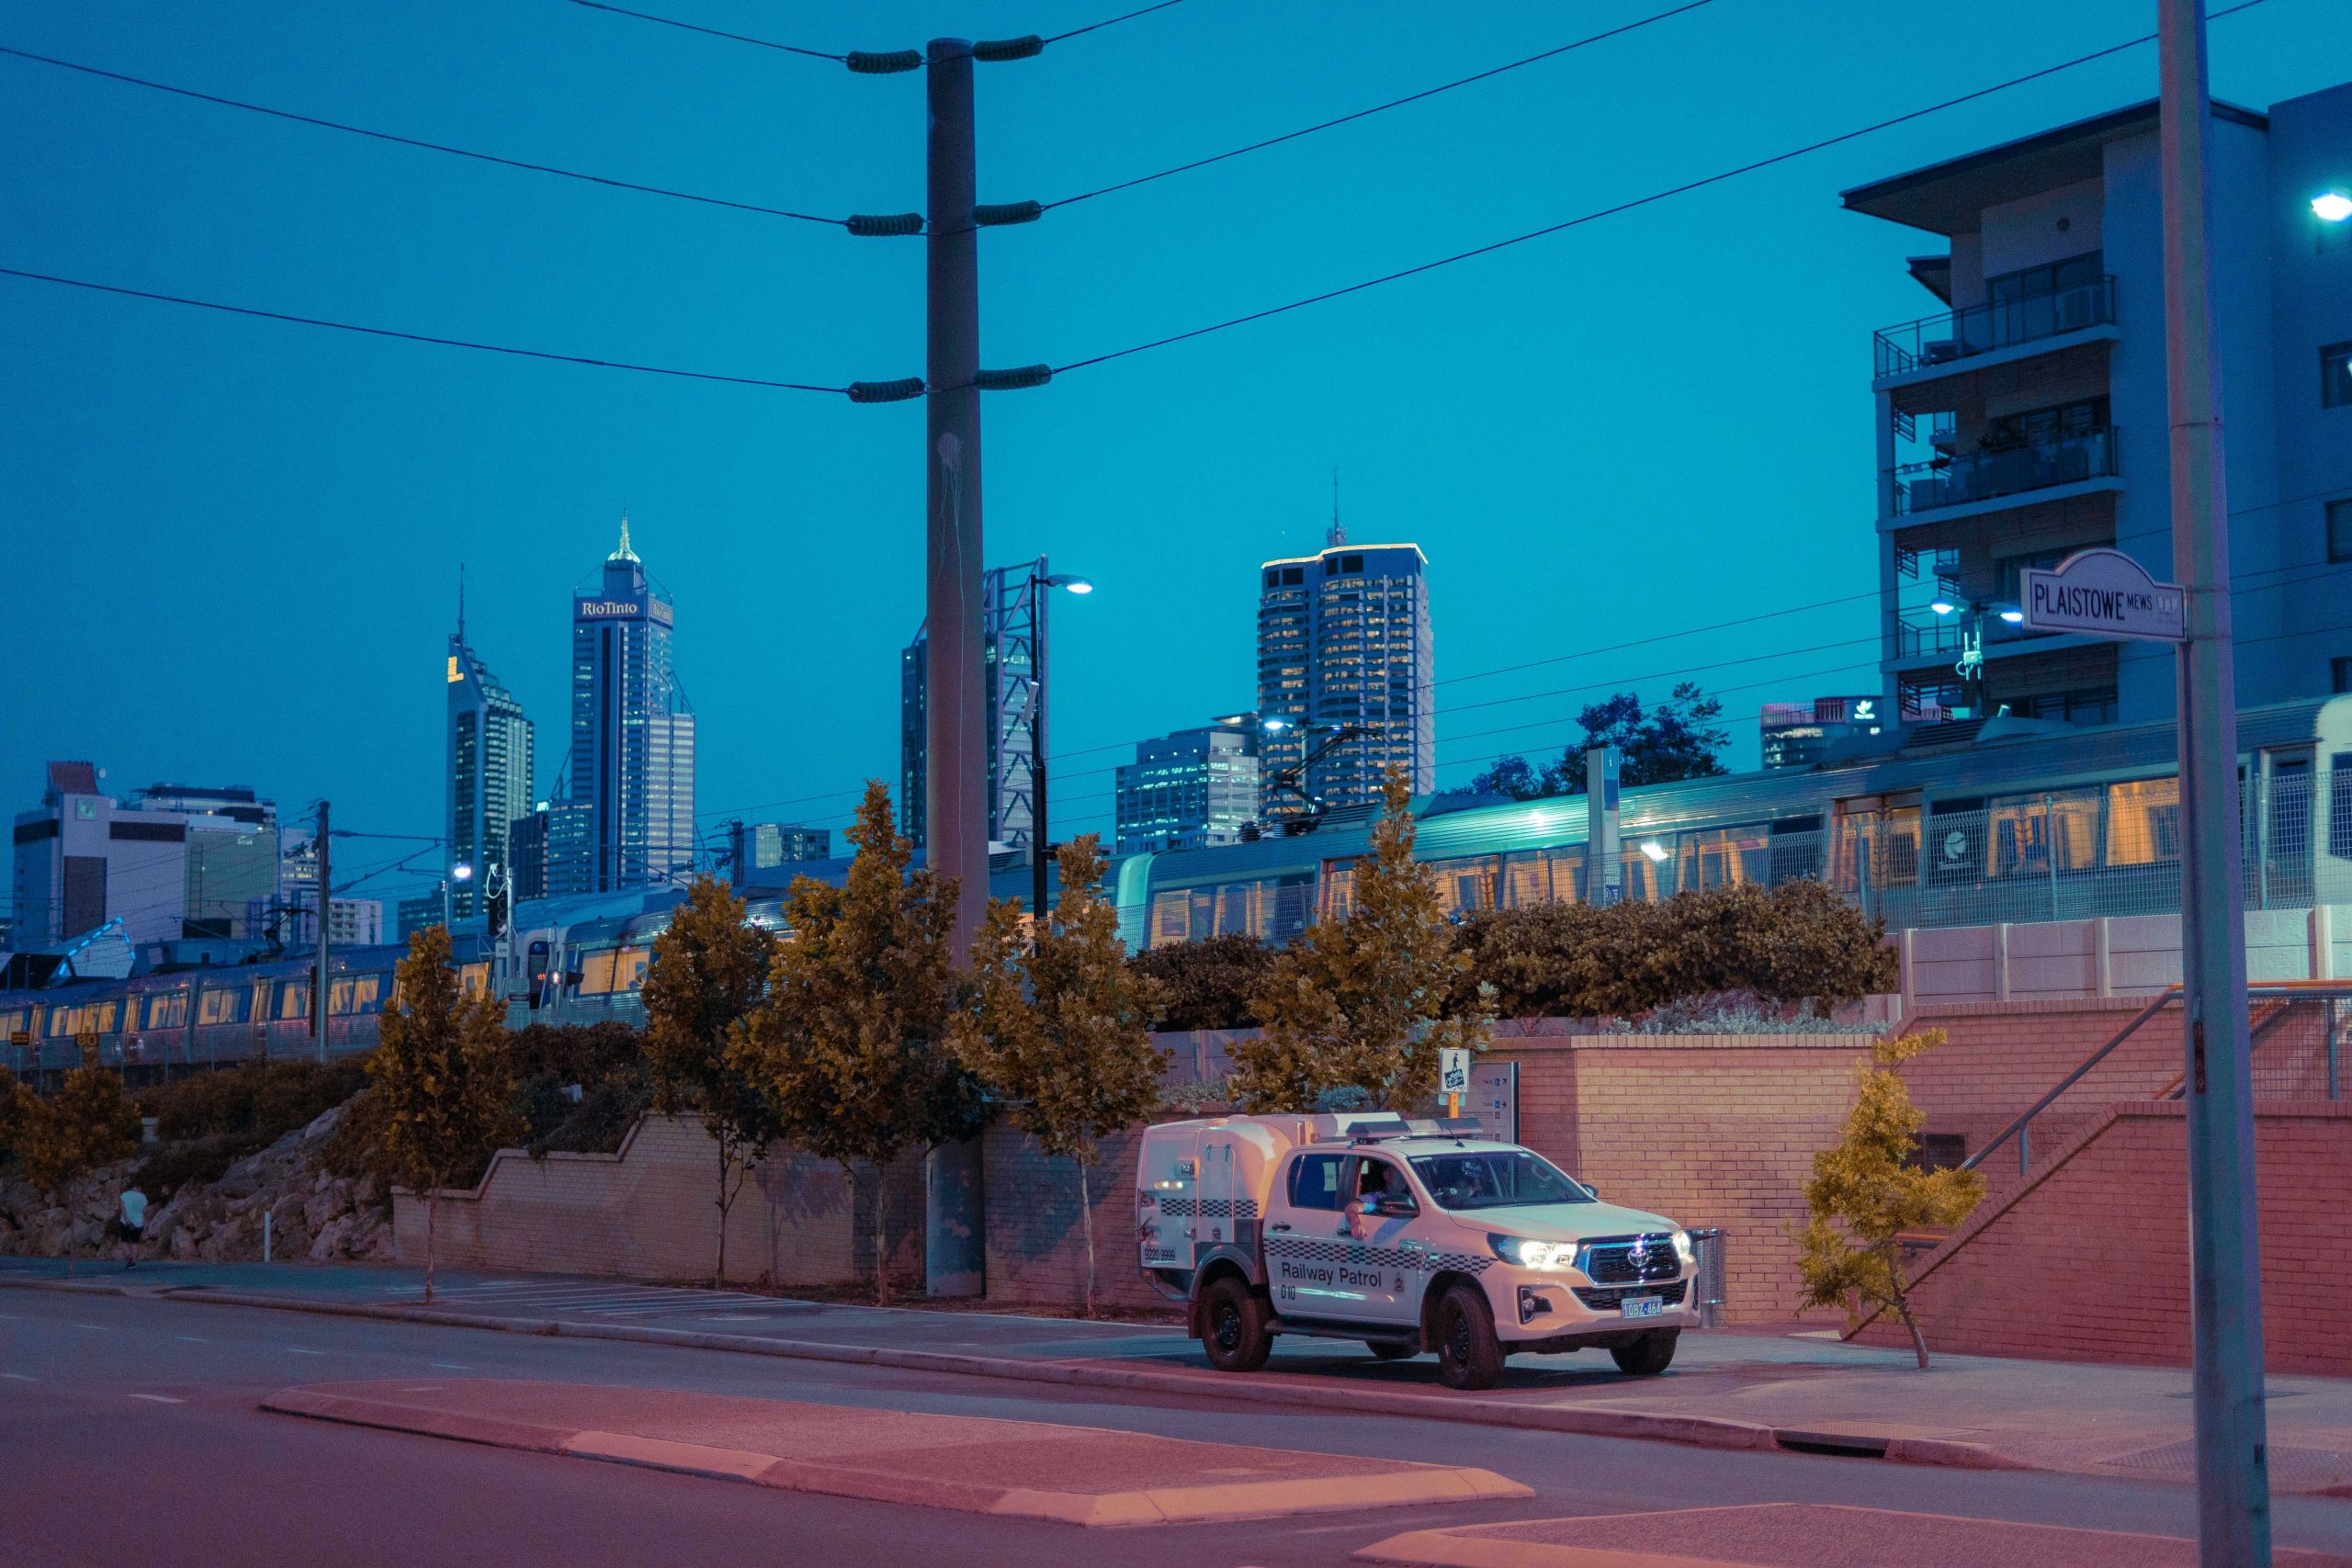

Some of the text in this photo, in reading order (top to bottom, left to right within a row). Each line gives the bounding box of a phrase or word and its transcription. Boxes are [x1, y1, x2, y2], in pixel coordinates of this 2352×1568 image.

[2034, 583, 2153, 621] PLAISTOWE MEWS
[1282, 1262, 1382, 1287] Railway Patrol
